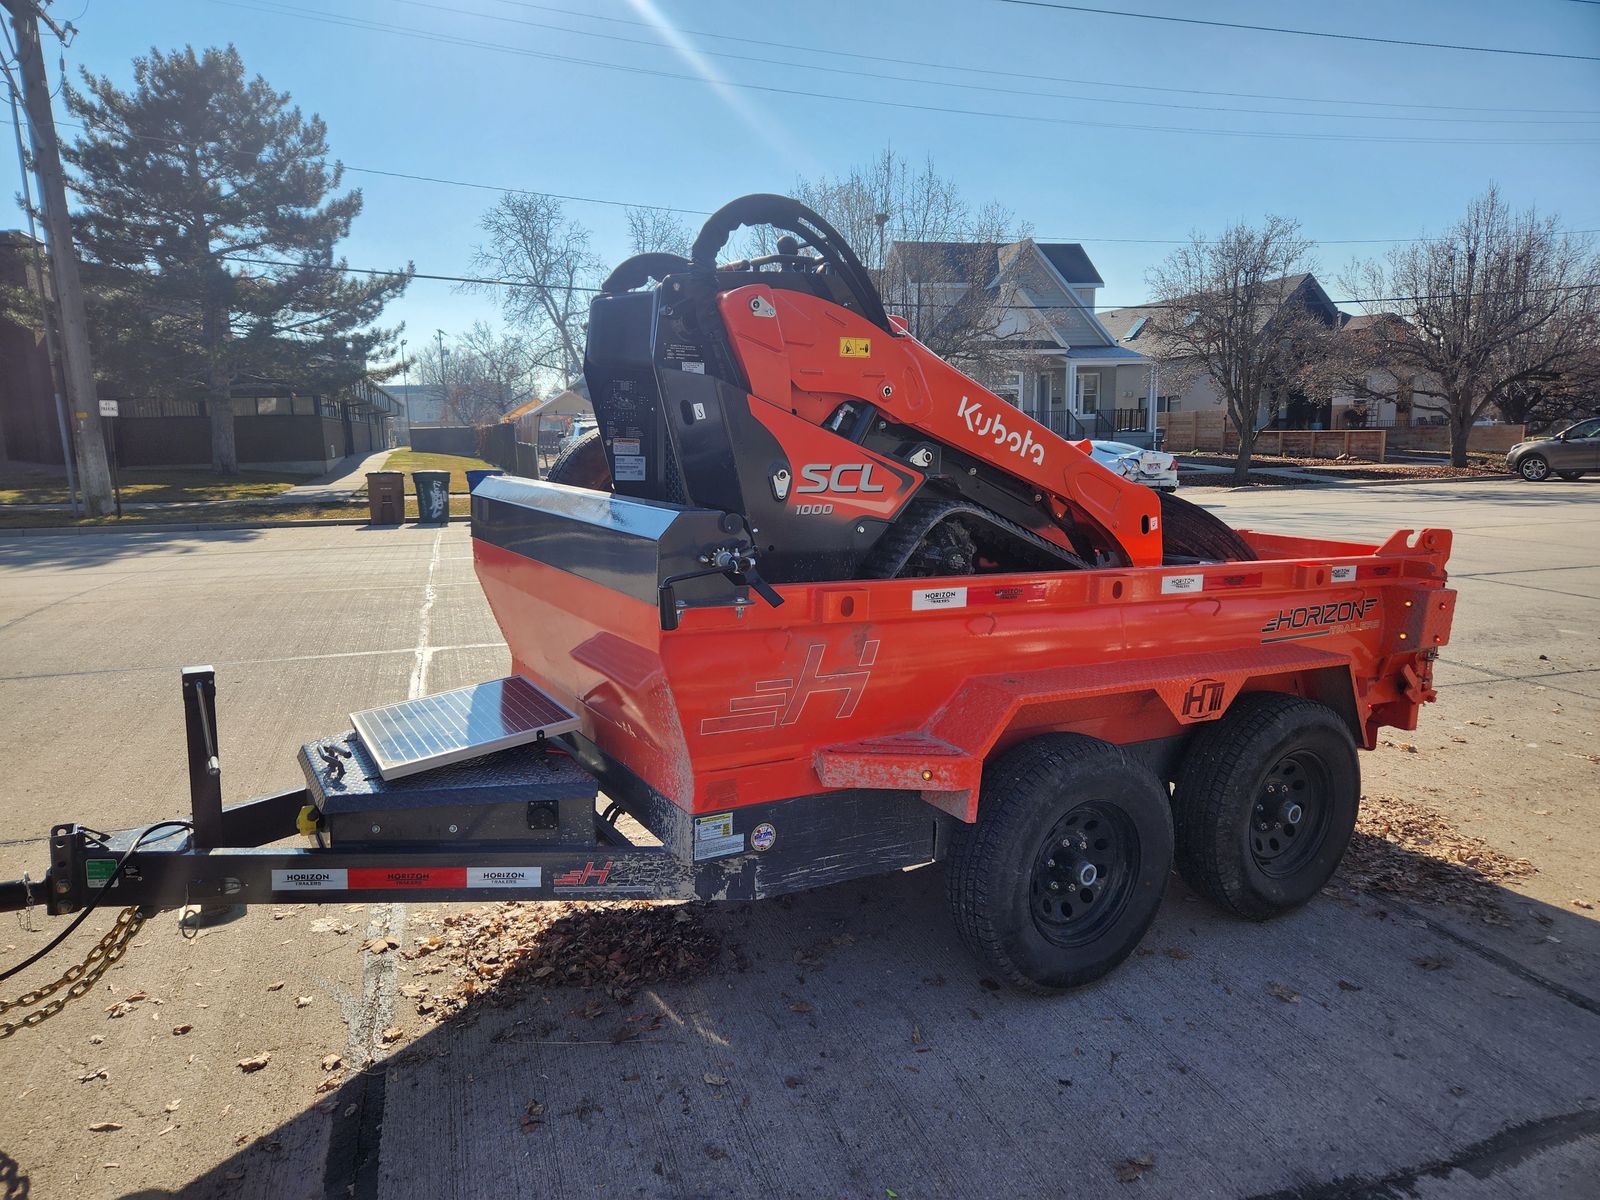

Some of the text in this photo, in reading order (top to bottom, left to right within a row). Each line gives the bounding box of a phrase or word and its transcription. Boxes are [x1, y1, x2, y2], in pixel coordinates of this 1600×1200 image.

[957, 396, 1045, 466] Kubota
[796, 463, 883, 493] SCL
[796, 504, 833, 515] 1000
[925, 591, 956, 600] HORIZON
[1276, 599, 1366, 631] HORIZON
[286, 873, 330, 881] HORIZON
